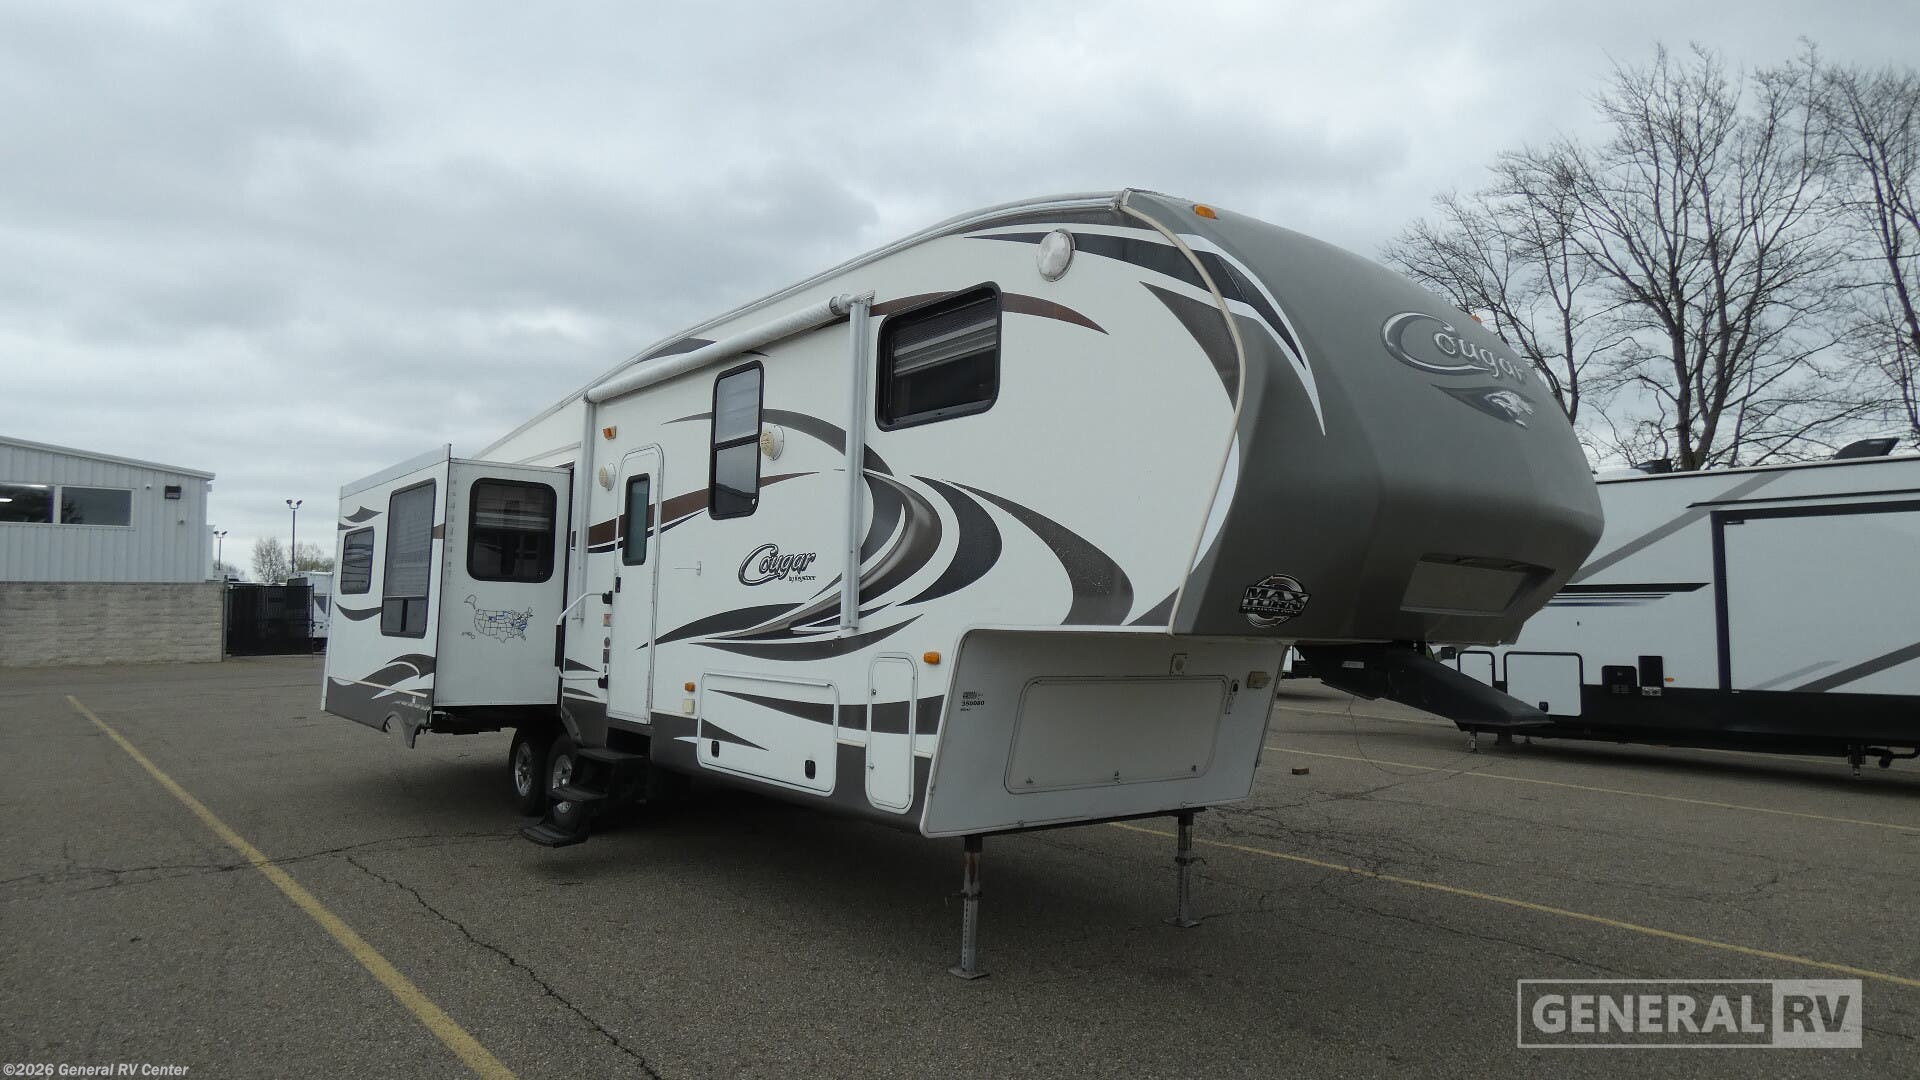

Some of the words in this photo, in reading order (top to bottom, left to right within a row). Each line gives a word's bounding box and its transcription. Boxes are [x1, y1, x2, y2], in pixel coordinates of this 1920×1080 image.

[1380, 311, 1525, 384] Cougar
[738, 543, 816, 586] Cougar
[1244, 586, 1310, 604] MAX
